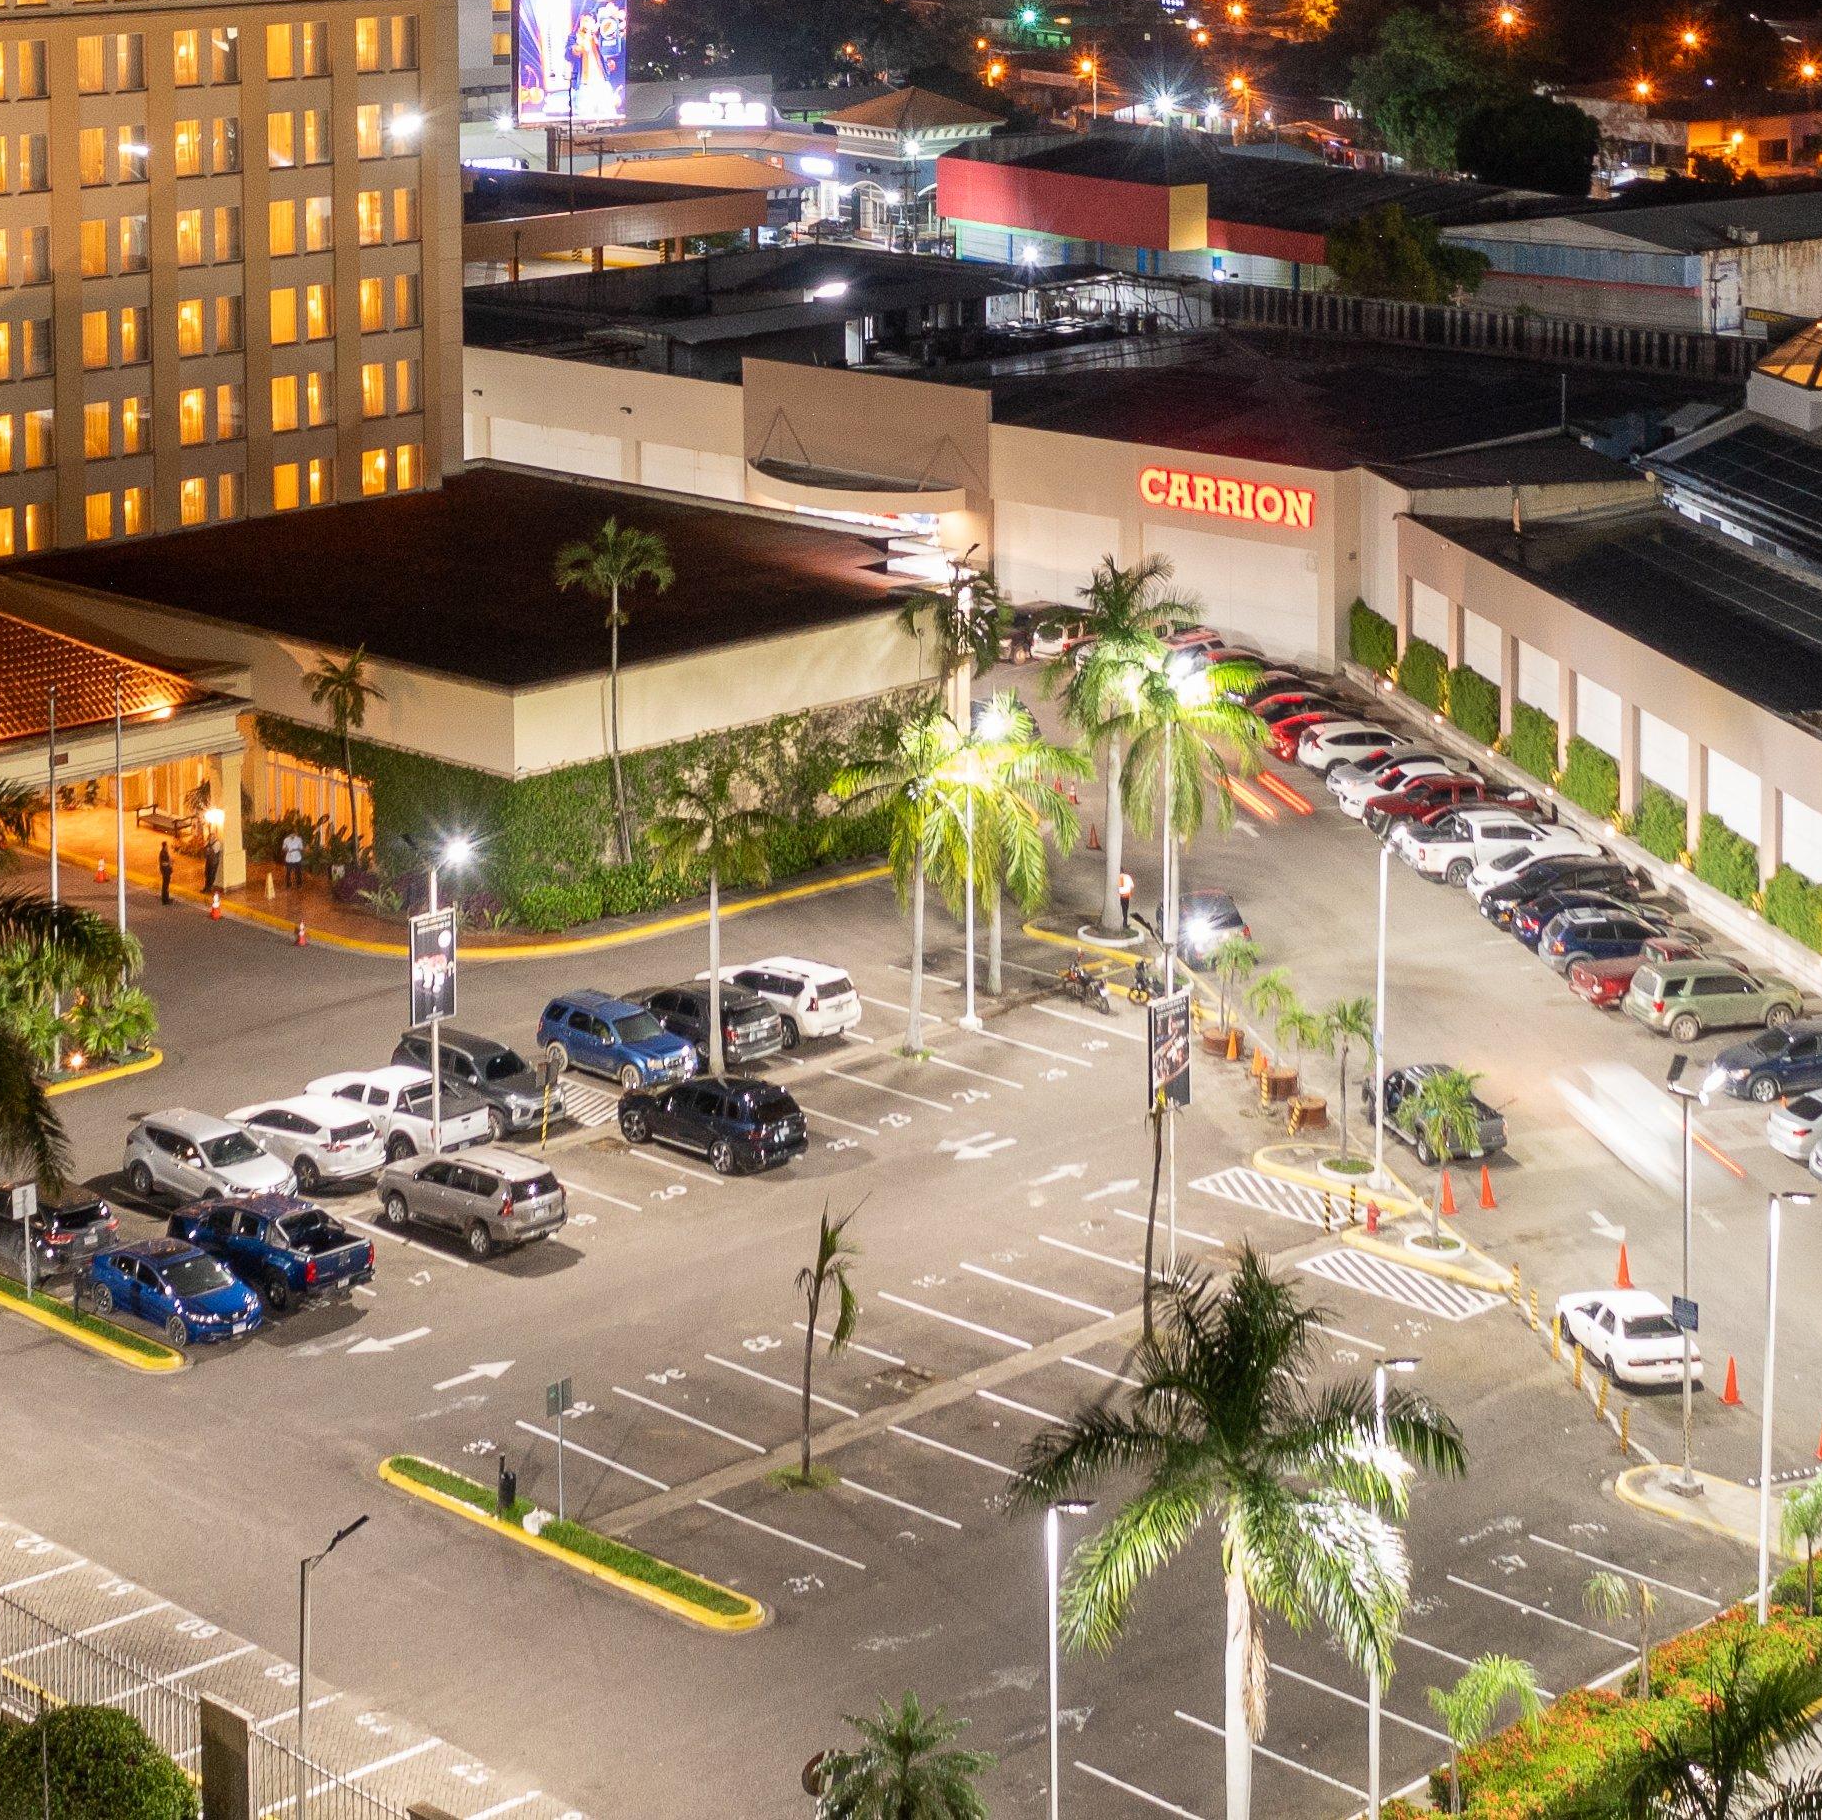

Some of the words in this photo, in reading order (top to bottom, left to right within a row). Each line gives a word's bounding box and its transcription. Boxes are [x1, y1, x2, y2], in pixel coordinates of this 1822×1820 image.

[1139, 466, 1315, 529] CARRION
[649, 1184, 687, 1200] 20
[15, 1535, 55, 1555] 62
[175, 1618, 220, 1640] 60
